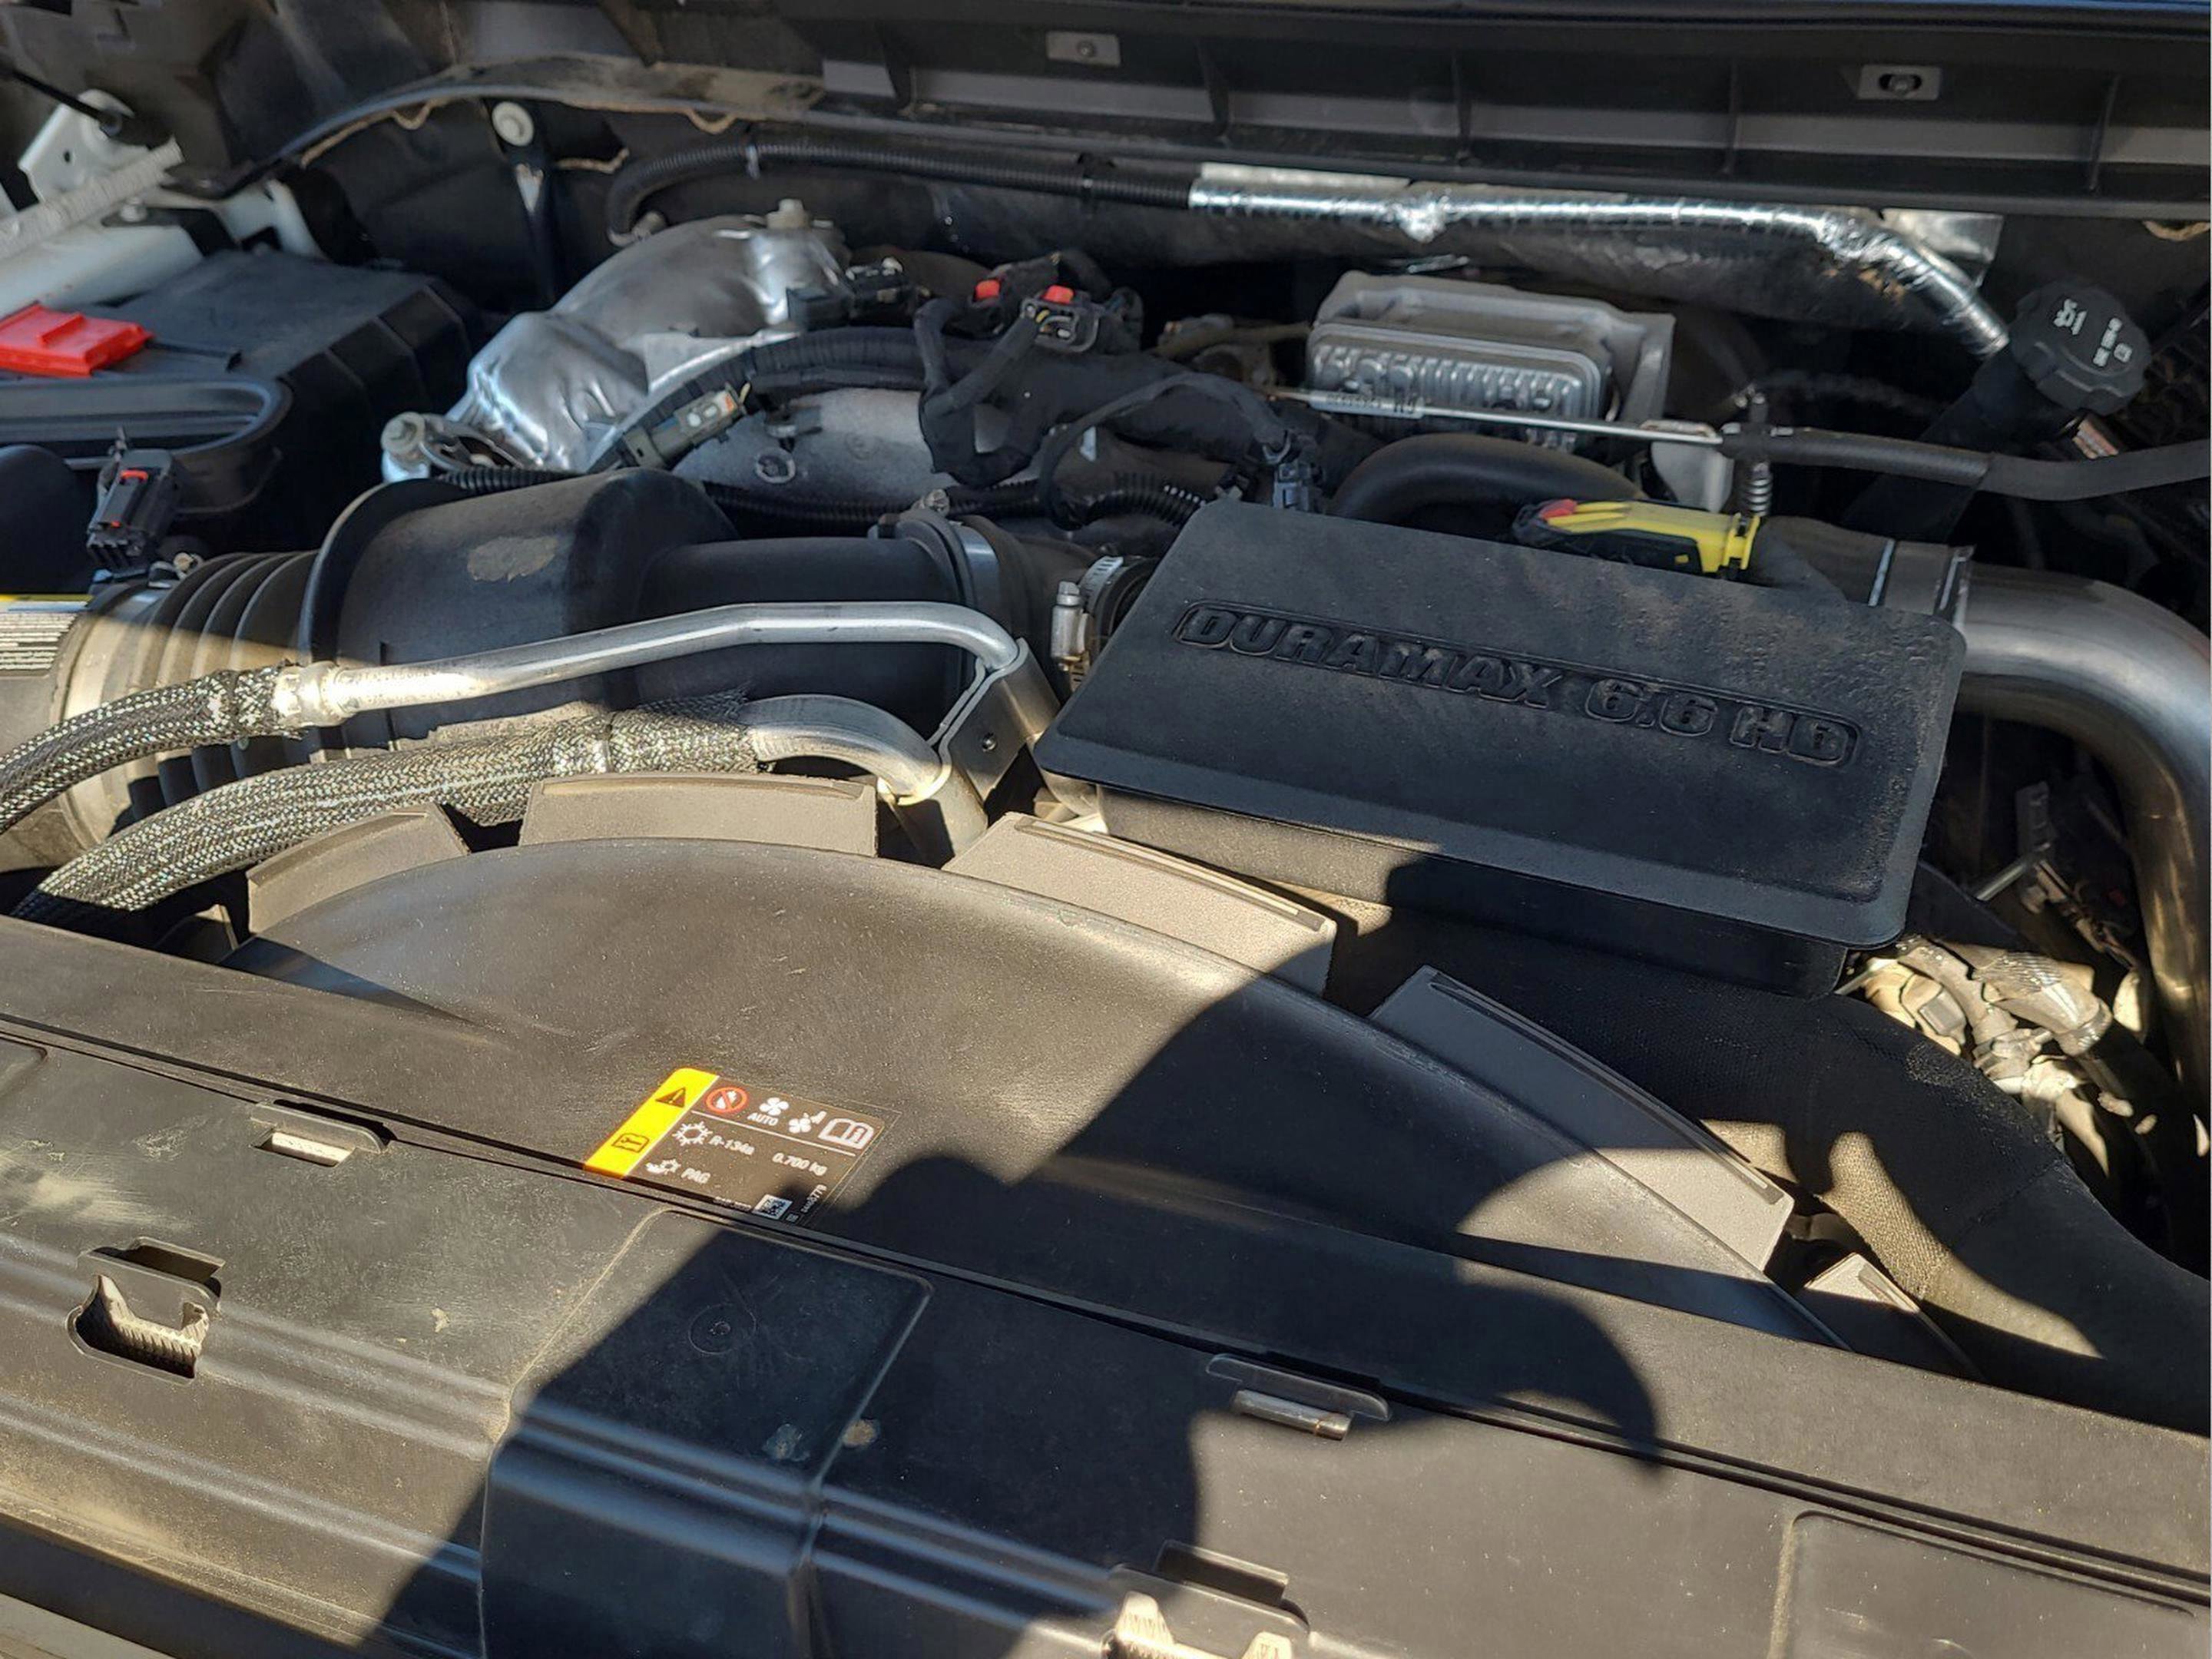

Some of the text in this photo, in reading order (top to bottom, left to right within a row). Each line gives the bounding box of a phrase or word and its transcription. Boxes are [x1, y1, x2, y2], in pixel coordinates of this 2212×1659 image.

[1179, 607, 1853, 765] DURAMAX 6.6 HD
[747, 1112, 779, 1126] AUTO
[709, 1135, 828, 1177] R-134a 0.700 kg
[680, 1167, 711, 1184] PAG
